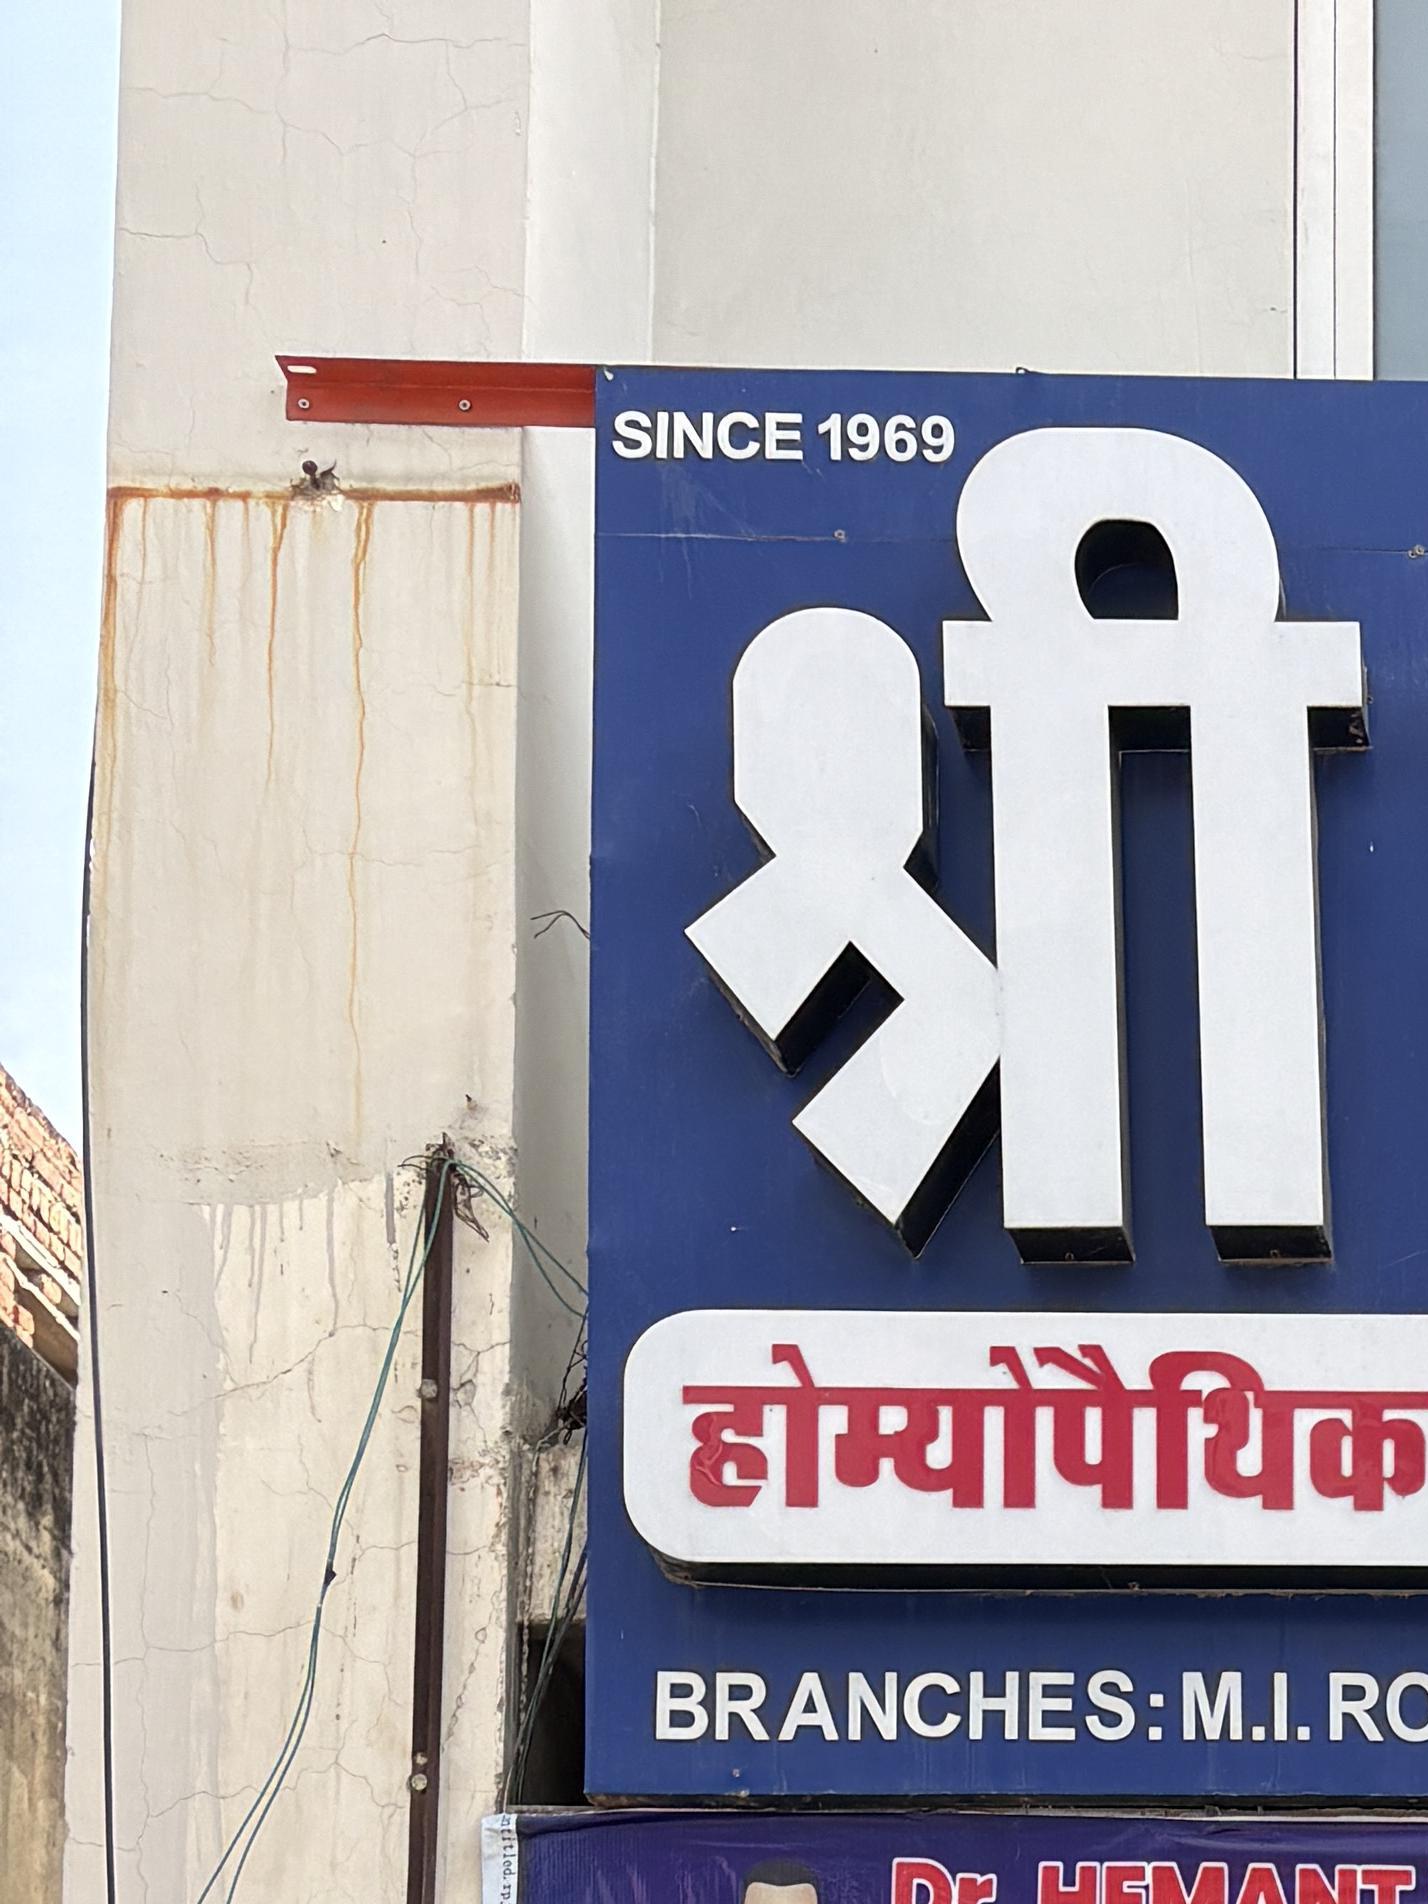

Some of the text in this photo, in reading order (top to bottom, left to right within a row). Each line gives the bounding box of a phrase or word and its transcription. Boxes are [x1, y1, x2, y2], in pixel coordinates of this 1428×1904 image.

[611, 411, 956, 464] SINCE 1969
[684, 426, 1364, 1240] श्री
